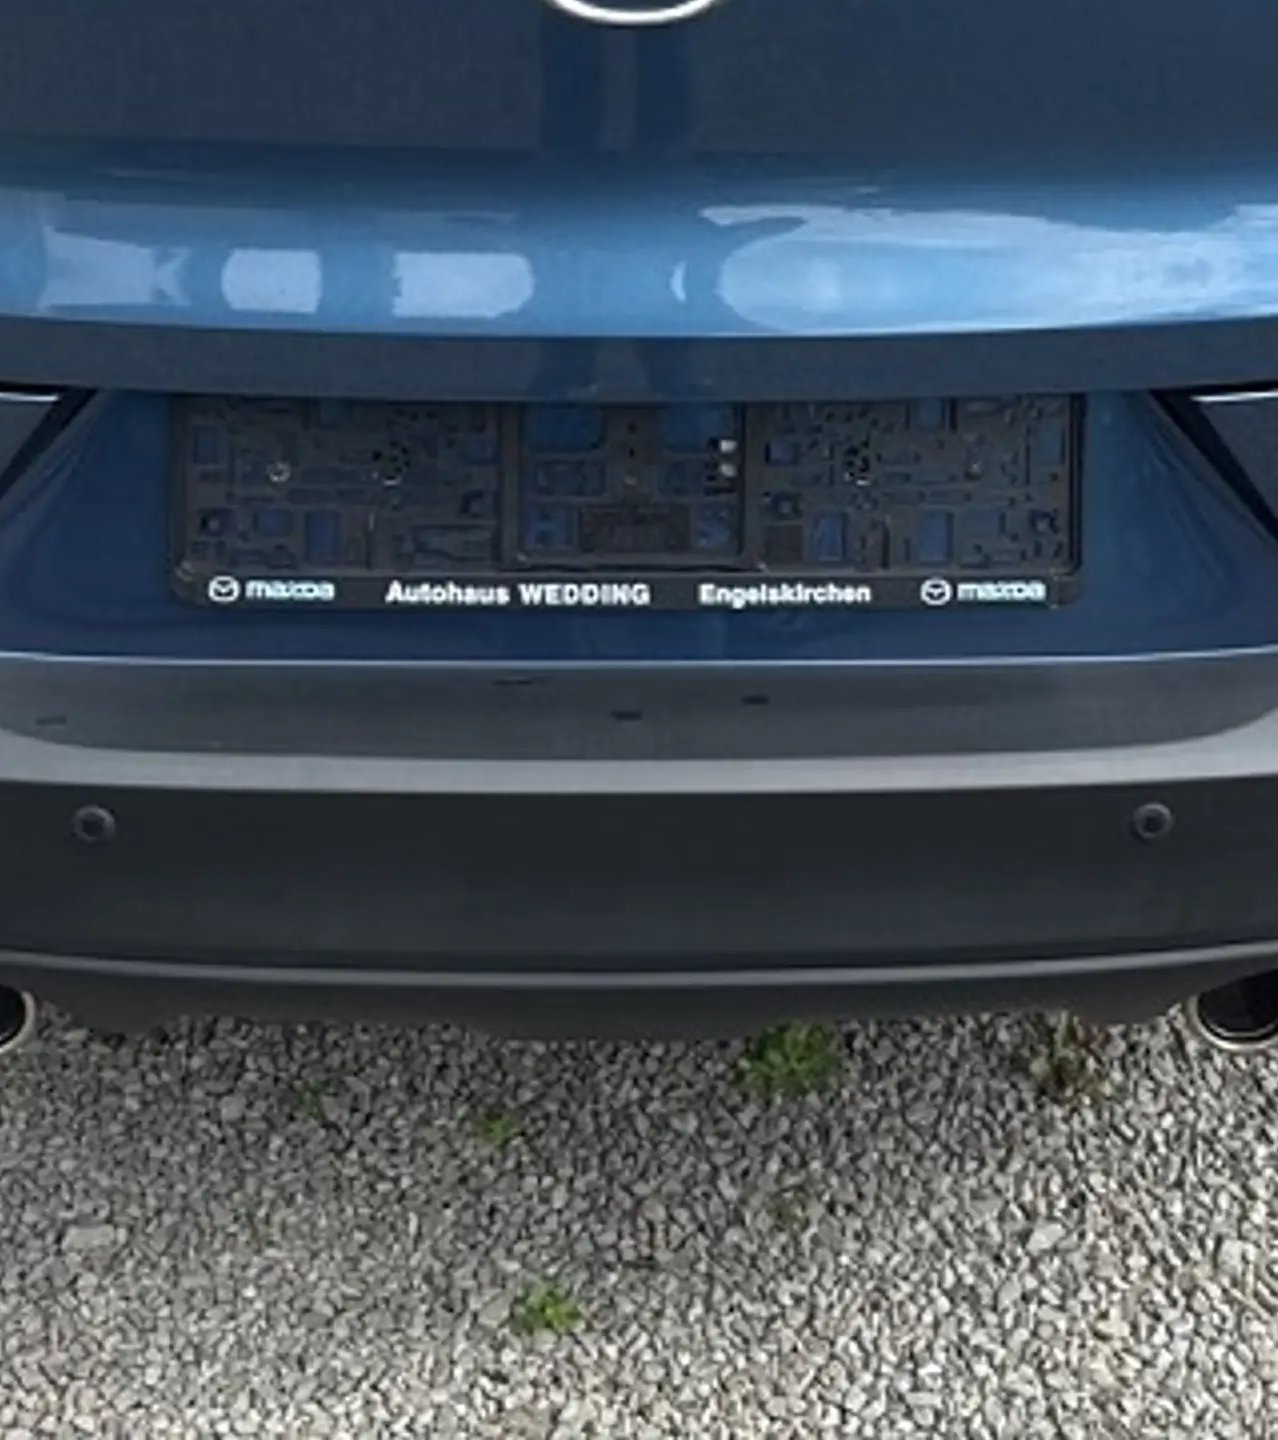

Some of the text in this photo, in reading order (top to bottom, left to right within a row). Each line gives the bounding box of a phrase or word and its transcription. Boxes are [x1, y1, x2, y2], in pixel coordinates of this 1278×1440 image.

[244, 578, 336, 600] mazda
[384, 579, 872, 609] Autohaus WEDDING Engelskirchen
[956, 579, 1047, 602] mazda
